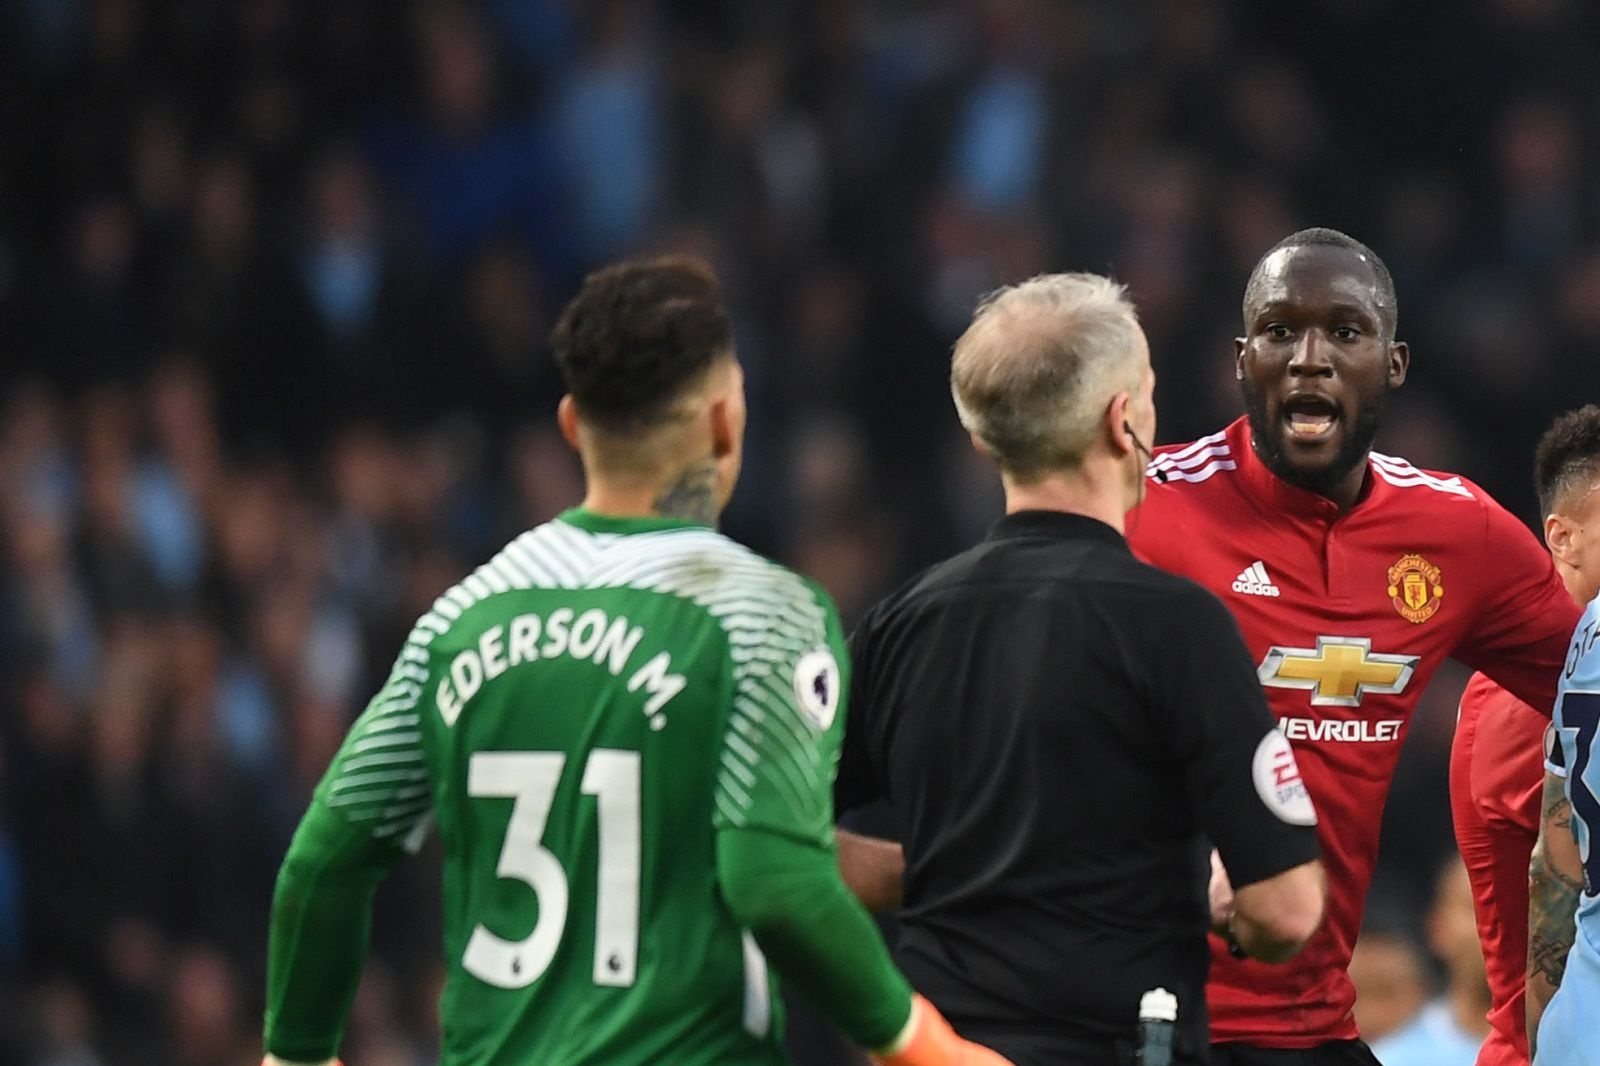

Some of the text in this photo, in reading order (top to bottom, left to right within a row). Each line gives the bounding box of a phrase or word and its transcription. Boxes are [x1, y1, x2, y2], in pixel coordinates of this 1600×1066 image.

[1231, 580, 1280, 597] adidas
[1401, 606, 1432, 620] UNITED
[436, 607, 687, 732] EDERSON M.
[1279, 717, 1404, 741] EVROLET
[462, 747, 642, 989] 31
